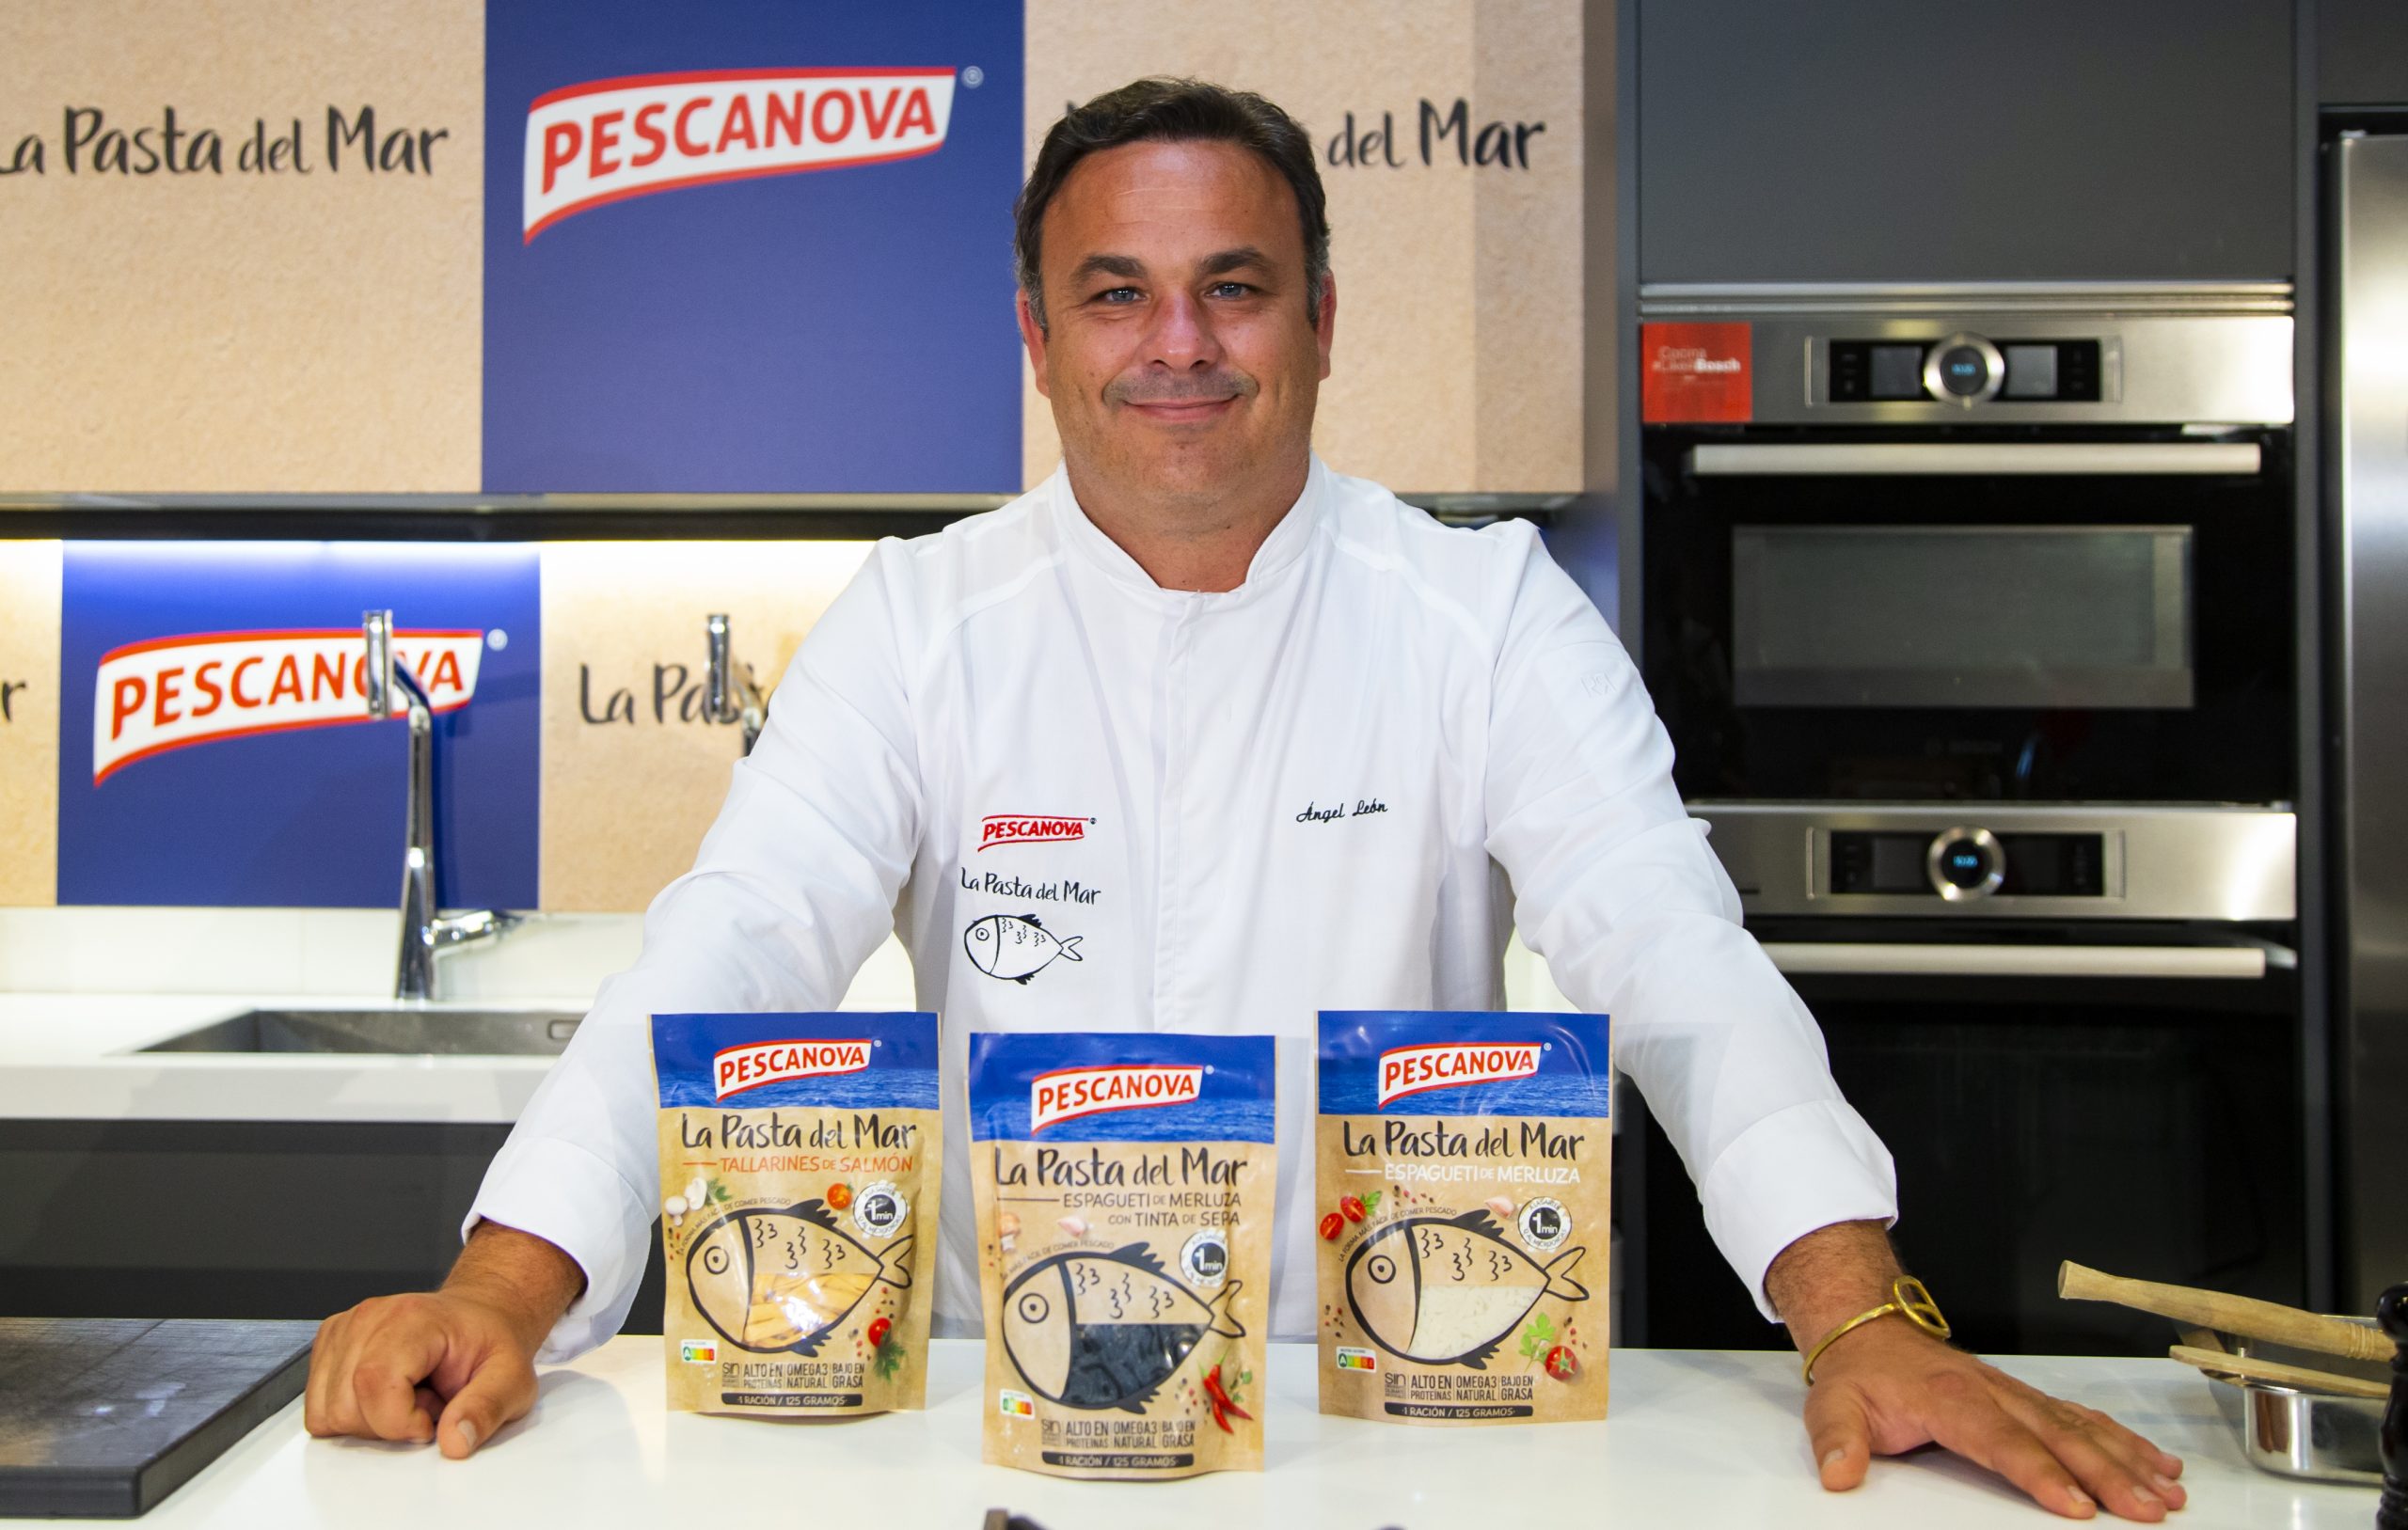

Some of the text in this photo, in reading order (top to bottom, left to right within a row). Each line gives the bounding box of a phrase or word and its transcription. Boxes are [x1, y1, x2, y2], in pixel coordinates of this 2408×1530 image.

[64, 104, 223, 176] Pasta
[238, 118, 312, 175] del
[326, 103, 450, 176] Mar
[542, 87, 937, 195] PESCANOVA
[1328, 97, 1545, 170] del Mar
[579, 662, 635, 725] La
[1296, 797, 1388, 823] Ángel León
[983, 820, 1084, 842] PESCANOVA
[961, 866, 1101, 905] La Pasta del Mar
[720, 1046, 865, 1088] PESCANOVA
[1385, 1050, 1534, 1092] PESCANOVA
[1038, 1073, 1195, 1117] PESCANOVA
[681, 1111, 917, 1150] La Pasta del Mar
[1343, 1120, 1585, 1160] La Pasta del Mar
[721, 1155, 819, 1174] TALLARINES
[839, 1153, 912, 1174] SALMÓN
[995, 1146, 1248, 1188] La Pasta del Mar
[1385, 1163, 1478, 1182] ESPAGUETI
[1497, 1166, 1581, 1184] MERLUZA
[1064, 1191, 1150, 1207] ESPAGUETI
[1169, 1191, 1242, 1207] MERLUZA
[1108, 1213, 1132, 1225] CON
[1135, 1211, 1178, 1226] TINTA
[1400, 1207, 1425, 1218] COMER
[1425, 1207, 1457, 1216] PESCADO
[743, 1363, 784, 1378] ALTO EN
[854, 1363, 864, 1374] EN
[786, 1377, 828, 1389] NATURAL
[832, 1375, 863, 1389] GRASA
[1411, 1375, 1452, 1389] ALTO EN
[1501, 1375, 1533, 1387] BAJO EN
[744, 1394, 776, 1406] RACIÓN
[785, 1396, 801, 1406] 125
[1457, 1389, 1497, 1401] NATURAL
[1501, 1387, 1533, 1400] GRASA
[1410, 1405, 1446, 1418] RACIÓN
[1456, 1409, 1470, 1418] 125
[1066, 1420, 1109, 1436] ALTO EN
[1185, 1420, 1196, 1431] EN
[1114, 1435, 1157, 1448] NATURAL
[1162, 1433, 1195, 1448] GRASA
[1065, 1455, 1102, 1466] RACIÓN
[1113, 1457, 1129, 1467] 125
